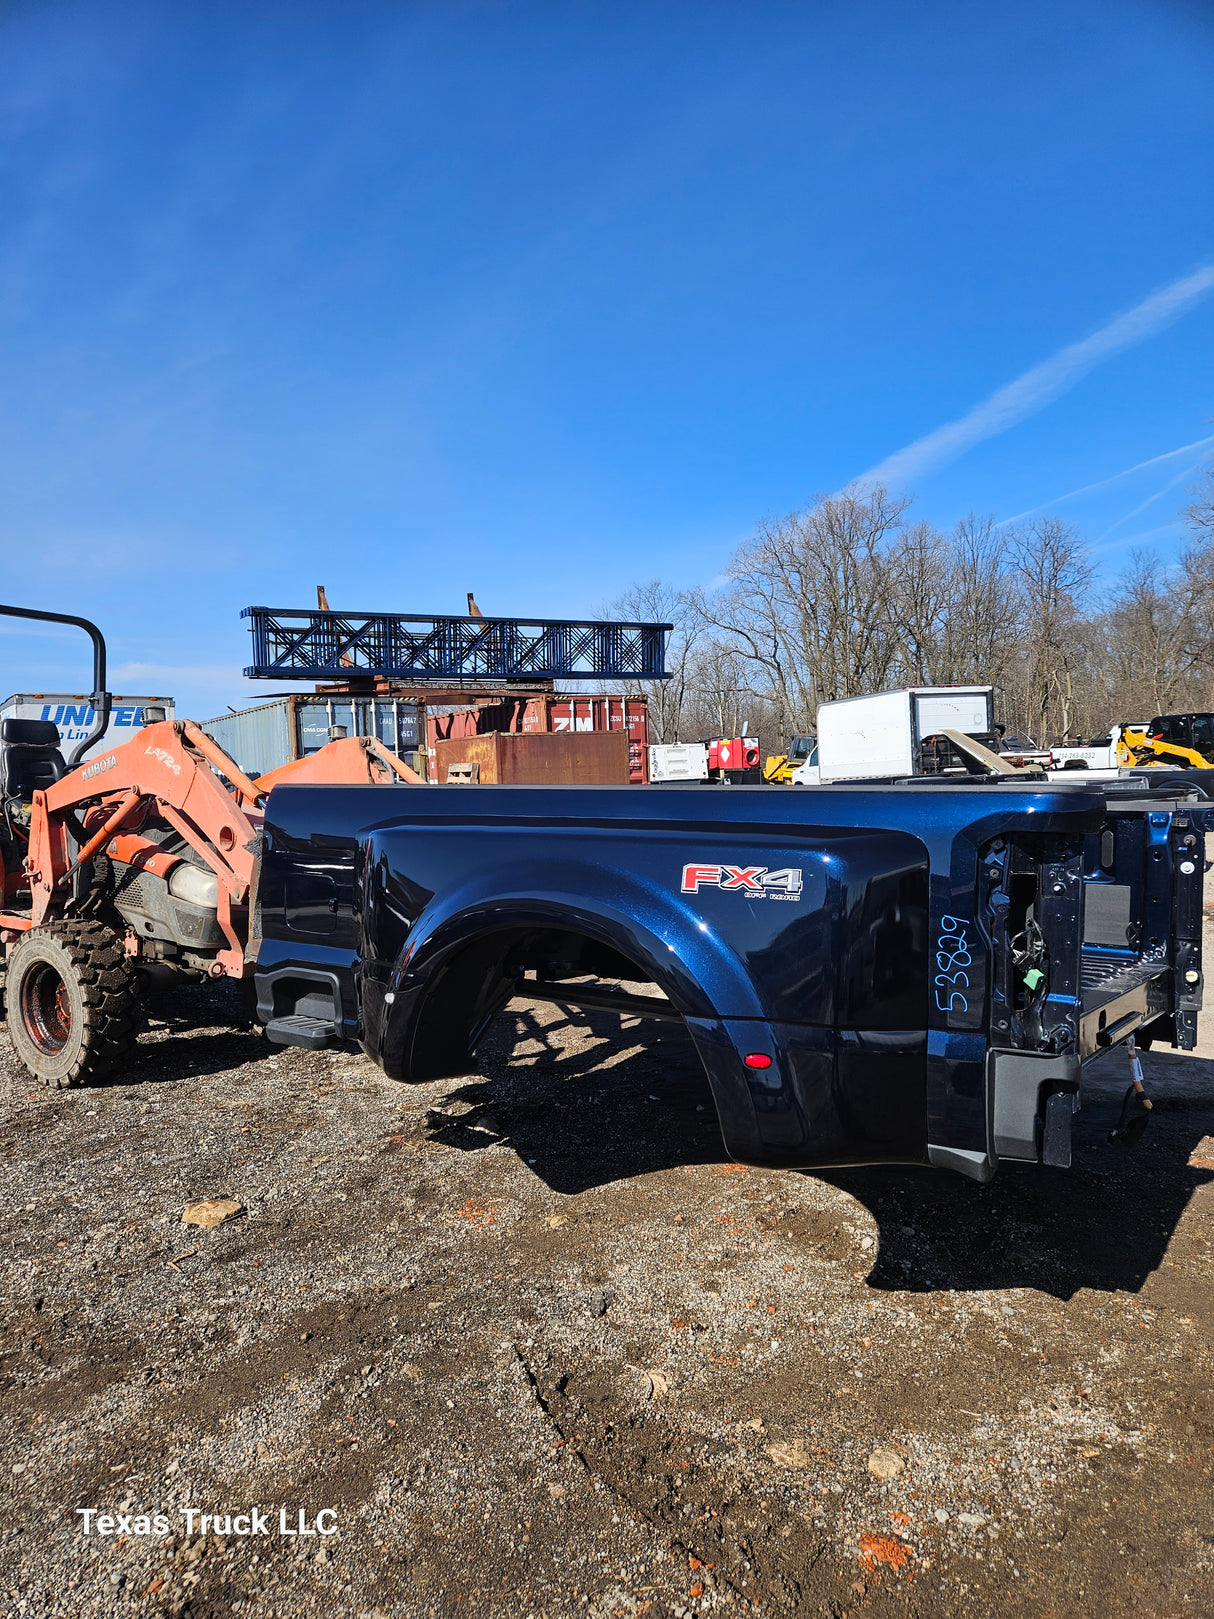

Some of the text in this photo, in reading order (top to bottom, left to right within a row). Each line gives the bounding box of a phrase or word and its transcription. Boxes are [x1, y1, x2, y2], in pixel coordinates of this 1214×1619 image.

[40, 705, 146, 726] UNIE
[553, 717, 594, 732] ZIM
[81, 754, 118, 781] KUBOTA
[680, 863, 803, 894] FX4
[935, 914, 972, 1012] 53829
